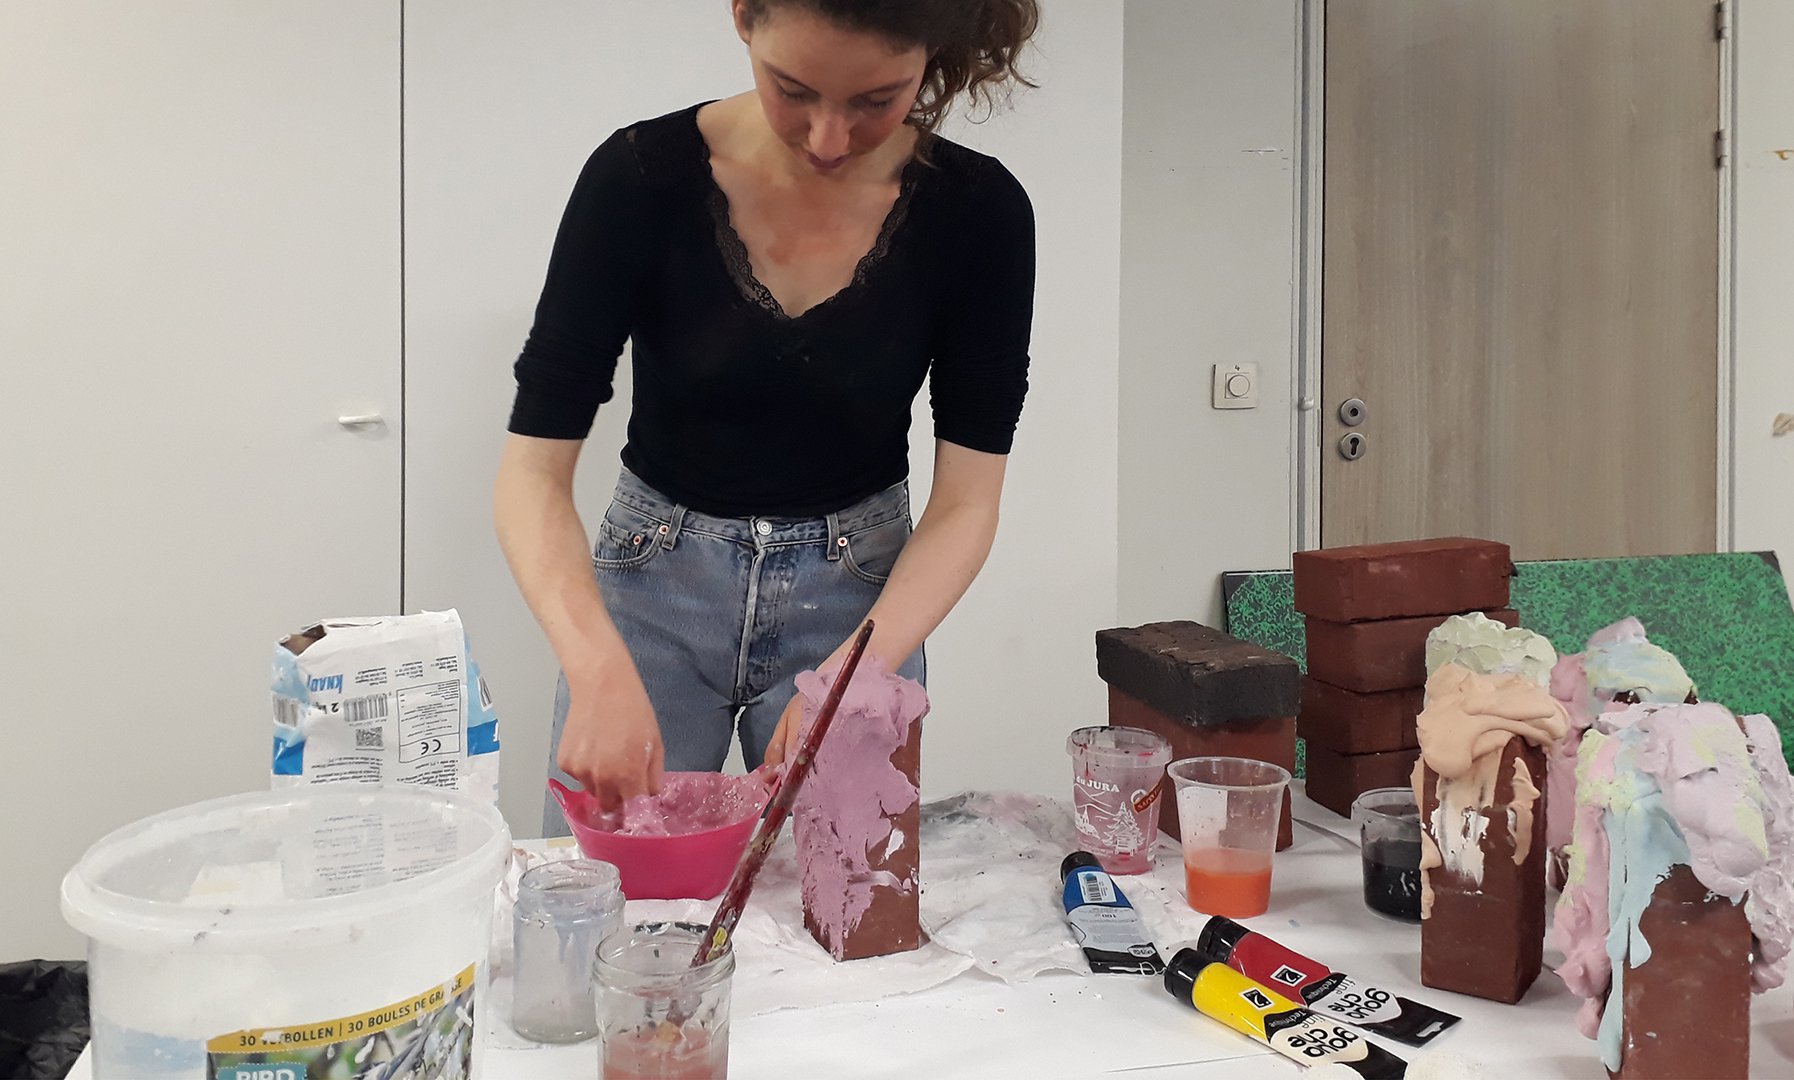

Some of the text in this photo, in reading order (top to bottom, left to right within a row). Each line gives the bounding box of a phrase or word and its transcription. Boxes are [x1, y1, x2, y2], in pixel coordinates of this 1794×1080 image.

[331, 702, 339, 713] 2
[1087, 779, 1120, 793] JURA
[1336, 977, 1356, 995] fine
[1327, 993, 1362, 1012] che
[1345, 988, 1390, 1019] goua
[239, 1035, 256, 1047] 30
[347, 1020, 364, 1033] 30
[367, 1004, 410, 1027] BOULES
[414, 998, 426, 1012] DE
[1302, 1013, 1326, 1029] fine
[1287, 1028, 1328, 1048] che
[1303, 1026, 1359, 1057] goua
